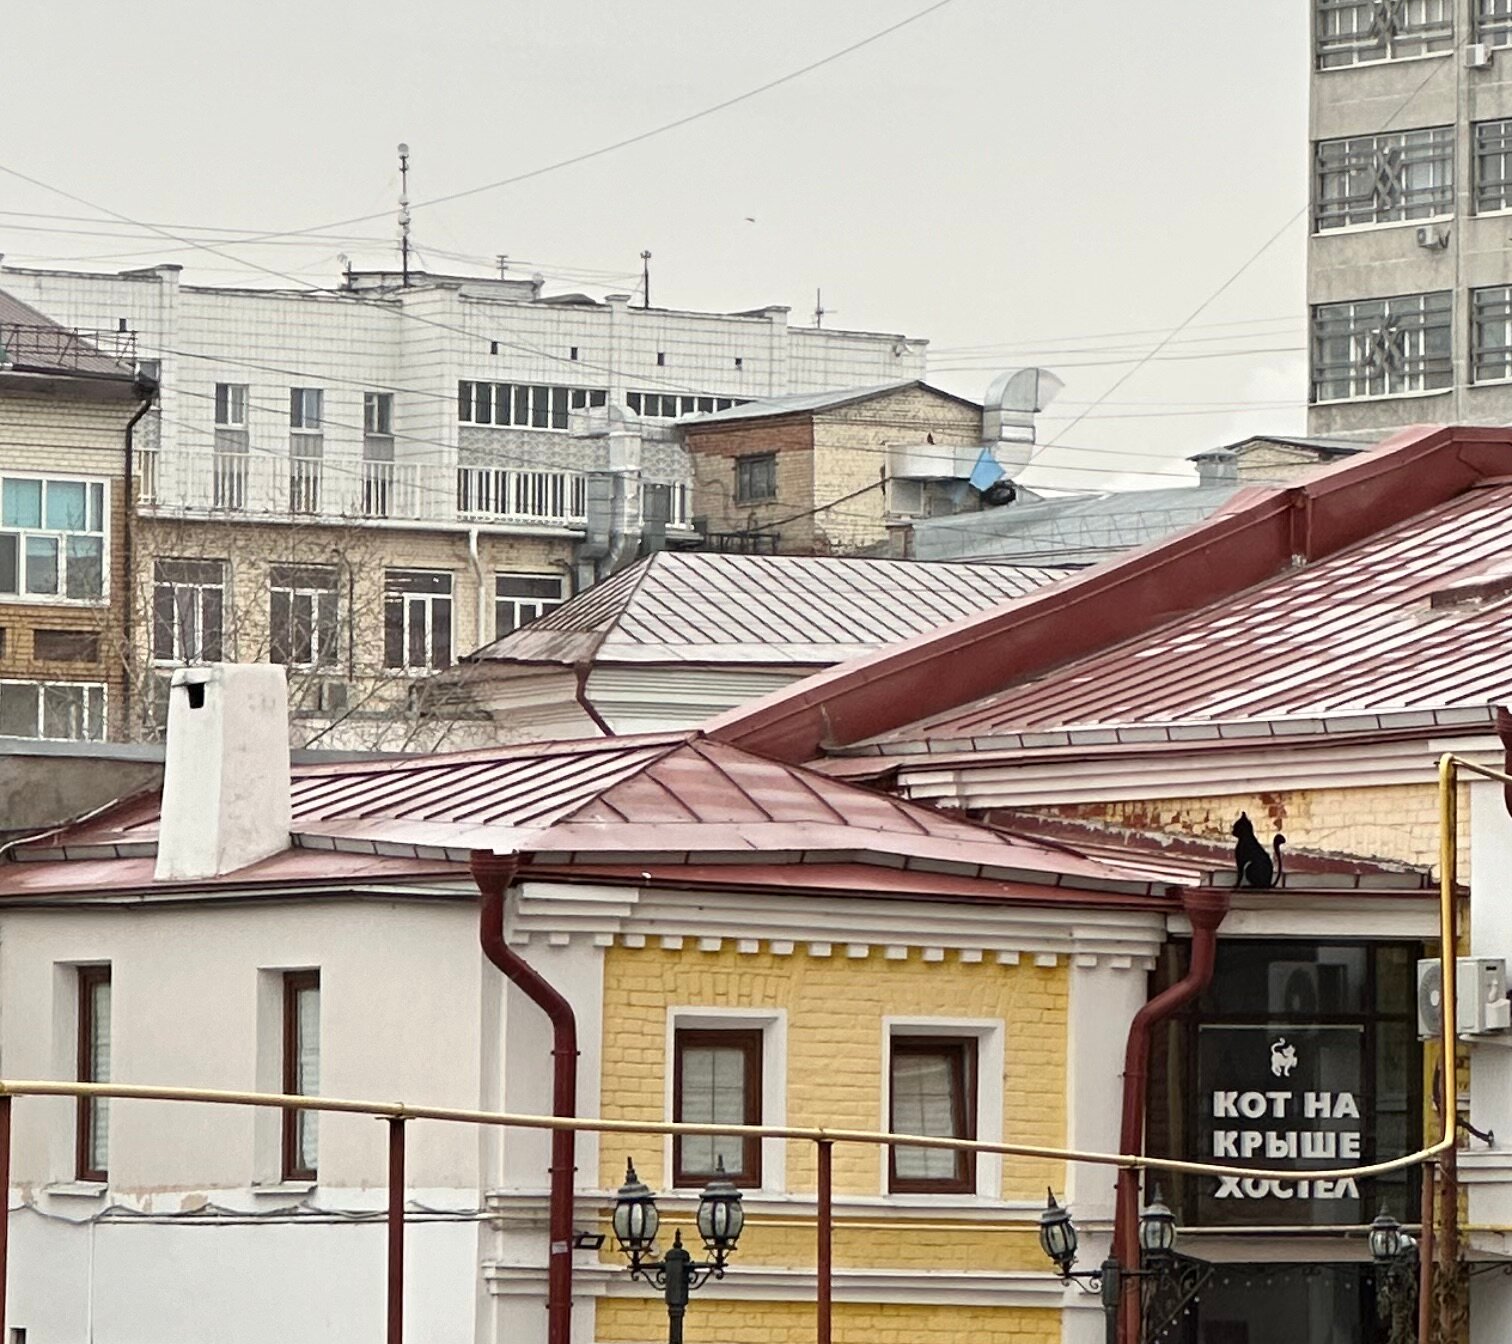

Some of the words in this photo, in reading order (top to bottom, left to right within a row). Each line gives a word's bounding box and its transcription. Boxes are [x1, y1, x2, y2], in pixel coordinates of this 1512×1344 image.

[1213, 1091, 1292, 1118] КОТ
[1303, 1091, 1360, 1119] НА
[1213, 1130, 1361, 1159] КРЫШЕ
